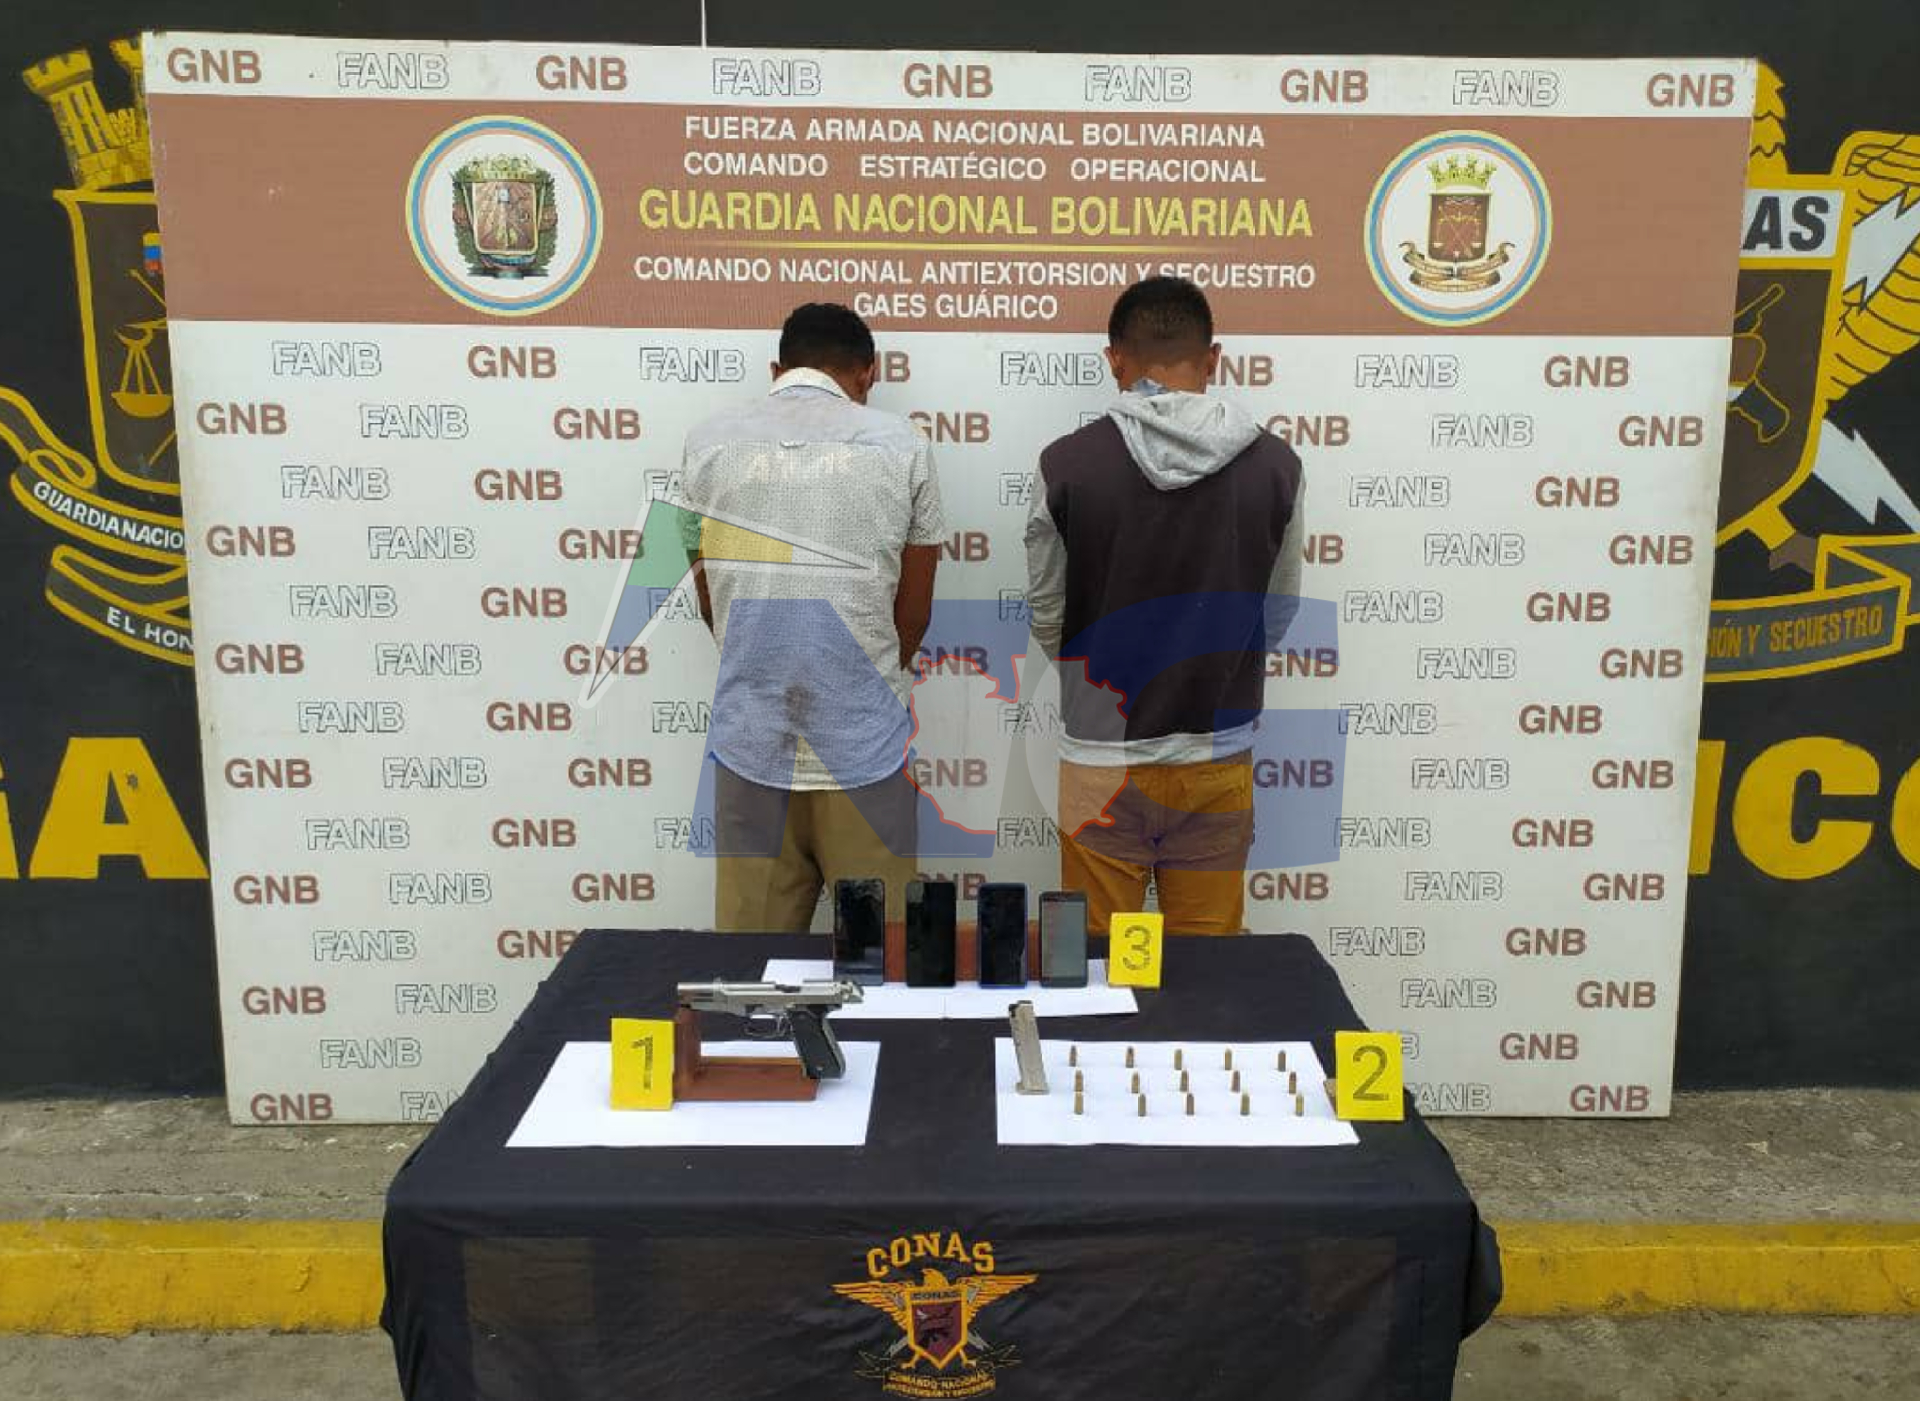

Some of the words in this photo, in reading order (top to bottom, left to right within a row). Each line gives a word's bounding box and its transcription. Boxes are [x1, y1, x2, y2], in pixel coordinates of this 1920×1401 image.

[168, 48, 262, 84] GNB
[336, 51, 449, 90] FANB
[536, 55, 628, 91] GNB
[712, 58, 821, 96] FANB
[903, 63, 993, 98] GNB
[1085, 65, 1191, 102] FANB
[1280, 69, 1368, 103] GNB
[1453, 70, 1561, 106] FANB
[1645, 73, 1735, 108] GNB
[686, 116, 796, 141] FUERZA
[806, 118, 924, 143] ARMADA
[933, 120, 1074, 146] NACIONAL
[1083, 123, 1265, 148] BOLIVARIANA
[684, 152, 828, 177] COMANDO
[860, 151, 1046, 181] ESTRATÉGICO
[1071, 157, 1266, 183] OPERACIONAL
[639, 188, 821, 231] GUARDIA
[834, 193, 1037, 235] NACIONAL
[1051, 196, 1312, 238] BOLIVARIANA
[634, 256, 771, 283] COMANDO
[779, 258, 913, 285] NACIONAL
[921, 260, 1126, 287] ANTIEXTORSION
[1135, 262, 1152, 281] Y
[854, 292, 927, 318] GAES
[935, 290, 1057, 319] GUÁRICO
[272, 341, 382, 377] FANB
[467, 345, 557, 379] GNB
[639, 347, 746, 382] FANB
[1000, 352, 1103, 386] FANB
[1208, 355, 1274, 386] NB
[1355, 354, 1459, 388] FANB
[1544, 356, 1630, 388] GNB
[196, 403, 287, 435] GNB
[359, 404, 469, 439] FANB
[553, 408, 641, 440] GNB
[1431, 414, 1534, 447] FANB
[1619, 415, 1703, 447] GNB
[281, 465, 391, 500] FANB
[474, 469, 563, 501] GNB
[644, 469, 682, 502] FA
[1348, 475, 1450, 508] FANB
[1536, 476, 1620, 508] GNB
[206, 525, 296, 557] GNB
[368, 526, 476, 560] FANB
[559, 528, 645, 560] GNB
[938, 532, 990, 561] NB
[1302, 534, 1343, 564] NB
[1424, 533, 1525, 566] FANB
[1608, 534, 1694, 566] GNB
[107, 606, 136, 634] EL
[289, 585, 398, 619] FANB
[481, 587, 567, 618] GNB
[648, 588, 705, 620] FA
[1344, 590, 1443, 623] FANB
[1526, 592, 1611, 623] GNB
[1747, 624, 1761, 655] Y
[1769, 604, 1884, 653] SECUESTRO
[215, 643, 304, 675] GNB
[375, 642, 482, 675] FANB
[564, 645, 649, 675] GNB
[1417, 647, 1517, 680] FANB
[1600, 647, 1683, 679] GNB
[298, 701, 405, 734] FANB
[486, 701, 573, 733] GNB
[652, 701, 713, 734] FAN
[997, 701, 1065, 736] FAN
[1338, 703, 1437, 735] FANB
[1519, 704, 1602, 735] GNB
[224, 758, 312, 789] GNB
[382, 757, 487, 790] FANB
[568, 758, 652, 788] GNB
[914, 758, 988, 788] GNB
[1253, 758, 1333, 788] GNB
[1412, 758, 1509, 790] FANB
[1592, 759, 1673, 790] GNB
[0, 737, 210, 879] A
[306, 818, 410, 851] FANB
[491, 818, 576, 849] GNB
[654, 817, 716, 849] FAN
[997, 817, 1060, 848] FAN
[1334, 818, 1431, 849] FANB
[1512, 818, 1594, 849] GNB
[233, 875, 320, 905] GNB
[389, 872, 492, 904] FANB
[572, 873, 655, 903] GNB
[1249, 872, 1329, 902] GNB
[1405, 871, 1502, 902] FANB
[1583, 873, 1664, 903] GNB
[313, 929, 417, 962] FANB
[1329, 927, 1425, 959] FANB
[1504, 927, 1587, 957] GNB
[1122, 924, 1153, 972] 3
[242, 985, 327, 1015] GNB
[395, 983, 498, 1015] FANB
[1400, 977, 1497, 1008] FANB
[1575, 979, 1656, 1009] GNB
[320, 1038, 422, 1069] FANB
[1500, 1033, 1580, 1061] GNB
[632, 1036, 654, 1089] 1
[1352, 1045, 1390, 1101] 2
[250, 1092, 333, 1121] GNB
[1569, 1084, 1652, 1112] GNB
[866, 1231, 996, 1279] CONAS
